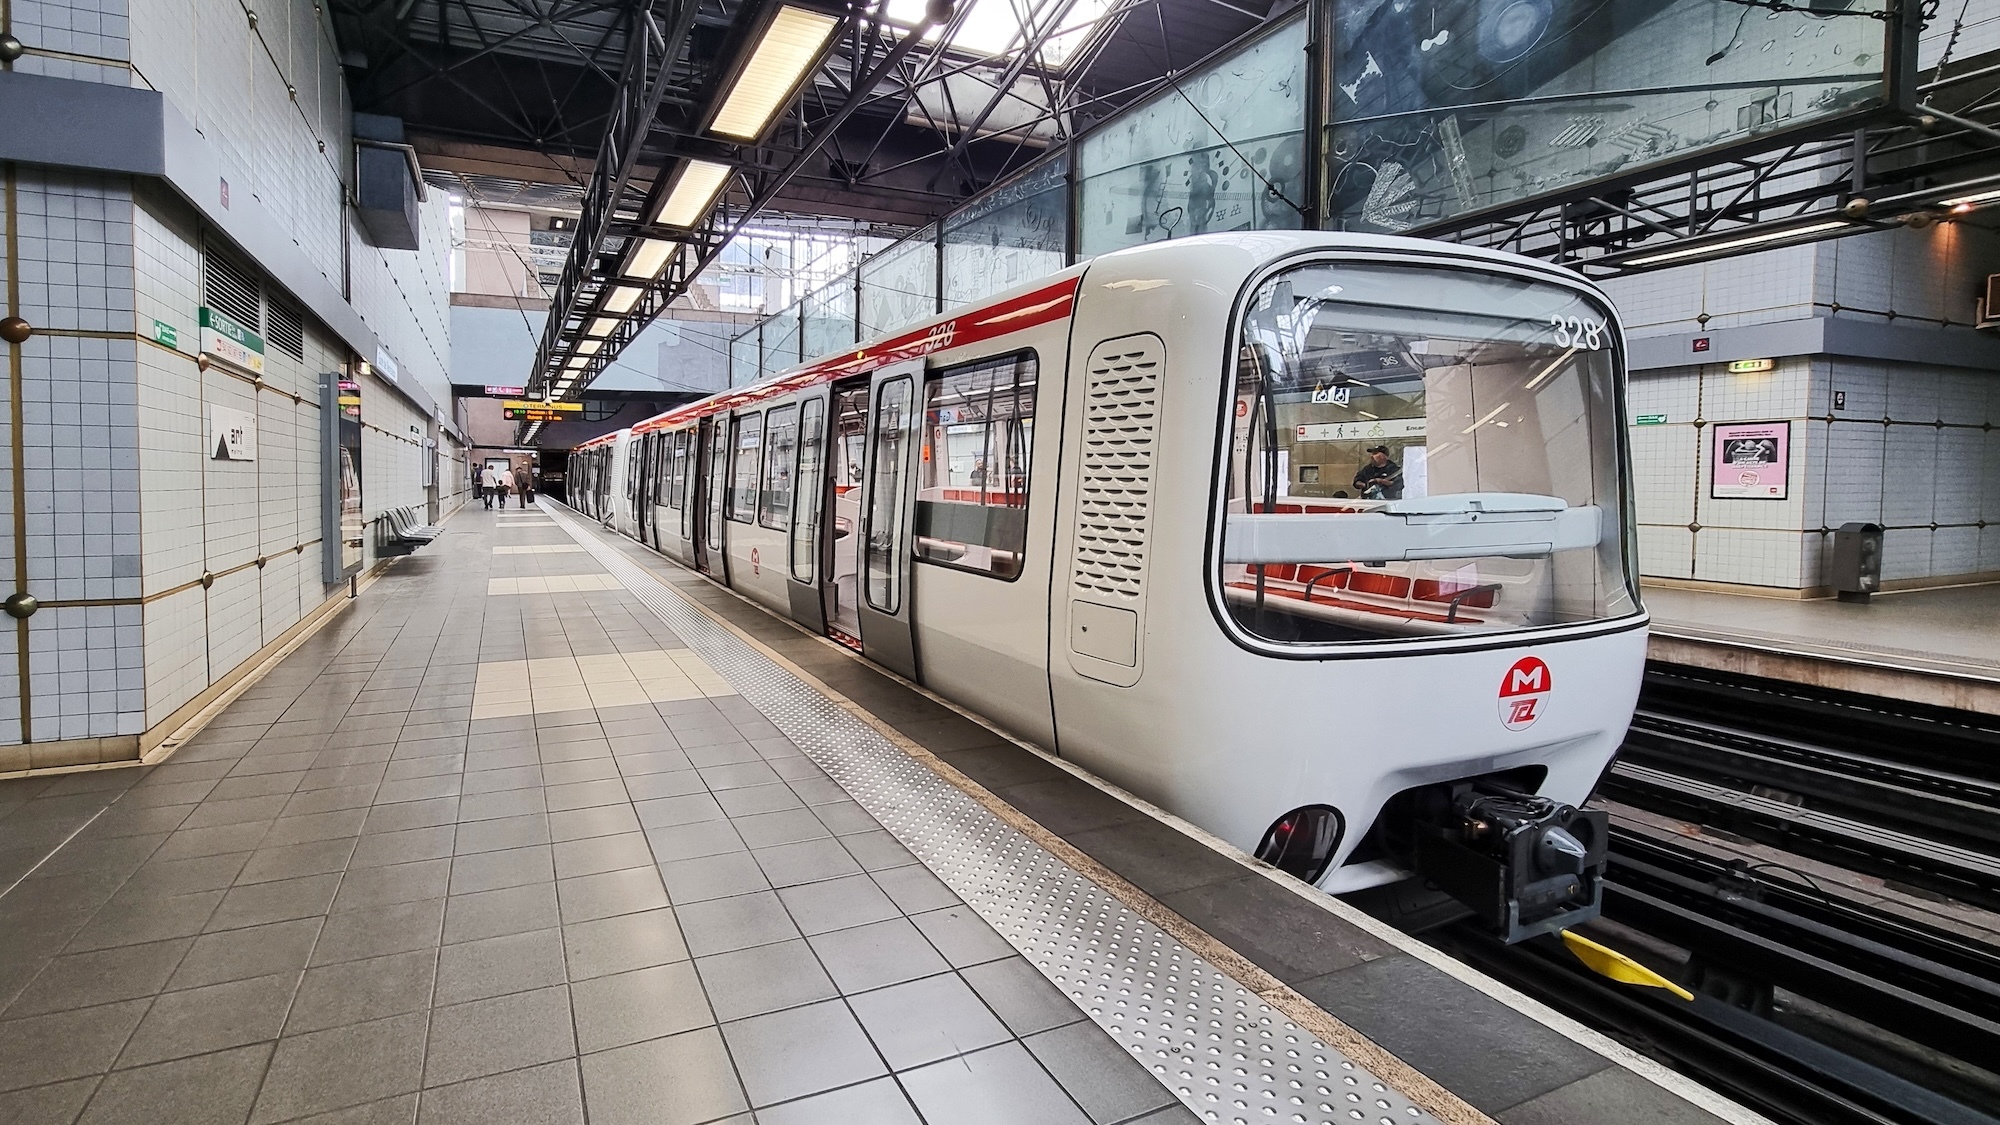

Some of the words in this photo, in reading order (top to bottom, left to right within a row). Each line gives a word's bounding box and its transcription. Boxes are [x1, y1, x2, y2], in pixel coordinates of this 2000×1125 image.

[925, 320, 956, 351] 328
[1551, 314, 1600, 350] 328
[1511, 666, 1543, 692] M
